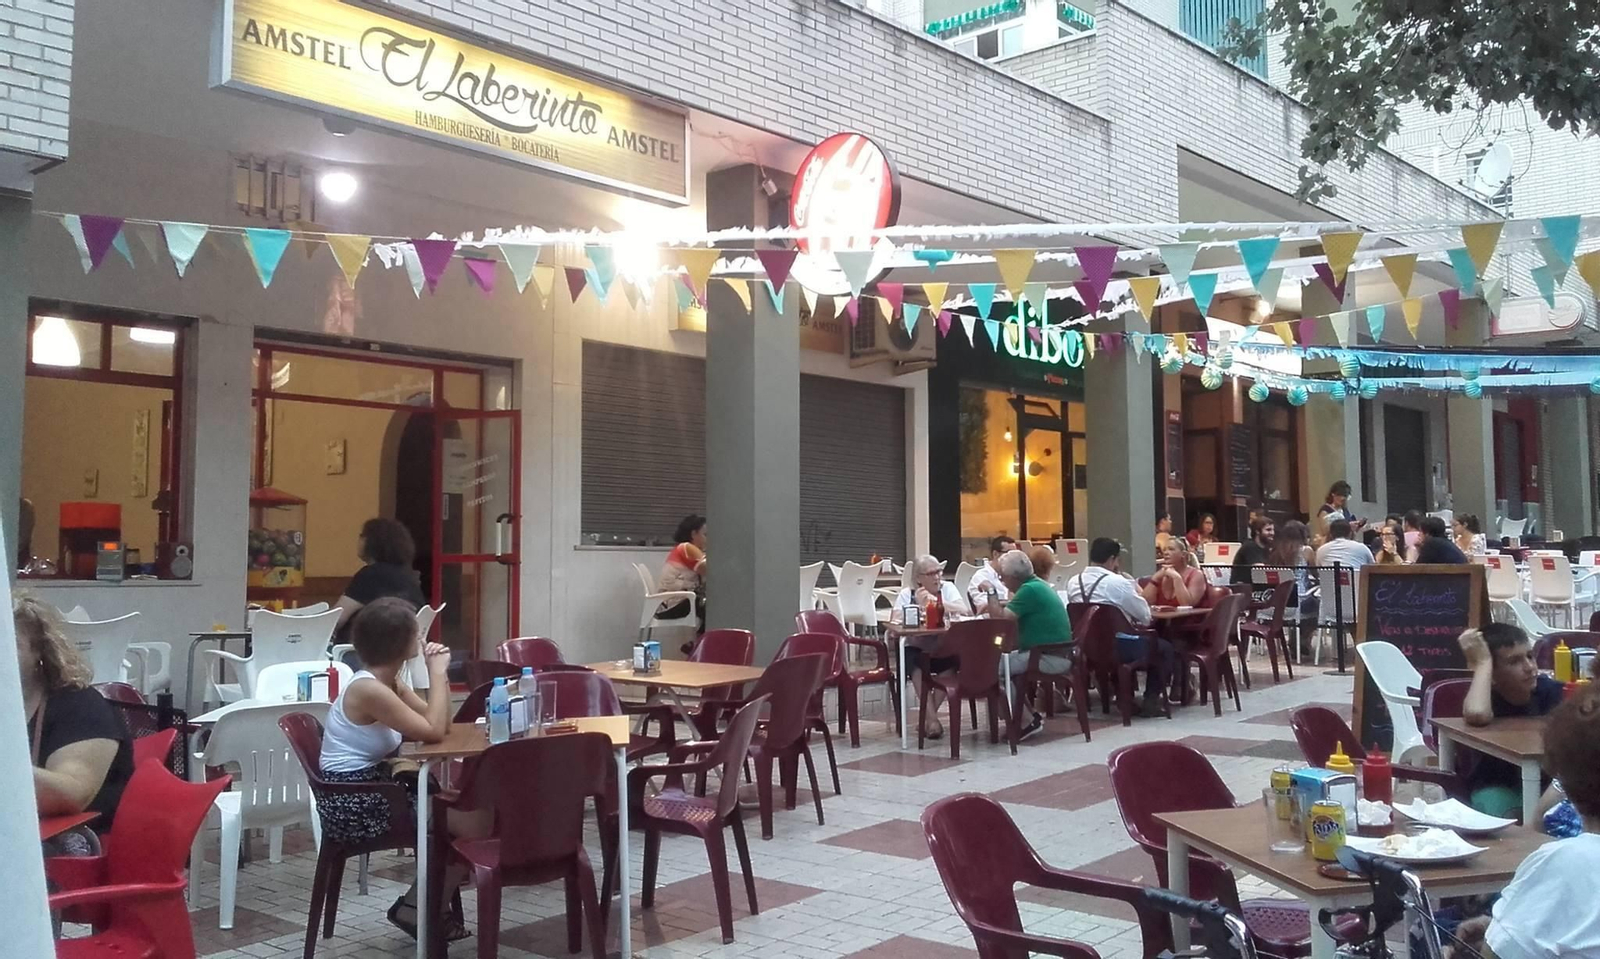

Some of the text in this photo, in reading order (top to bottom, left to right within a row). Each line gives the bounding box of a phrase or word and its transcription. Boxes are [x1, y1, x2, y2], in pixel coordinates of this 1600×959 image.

[241, 17, 351, 71] AMSTEL
[359, 26, 603, 135] El Laberinto
[414, 110, 560, 163] HAMBURGUESERÍA BOCATERÍA
[606, 125, 680, 164] AMSTEL
[1002, 292, 1085, 369] dibo
